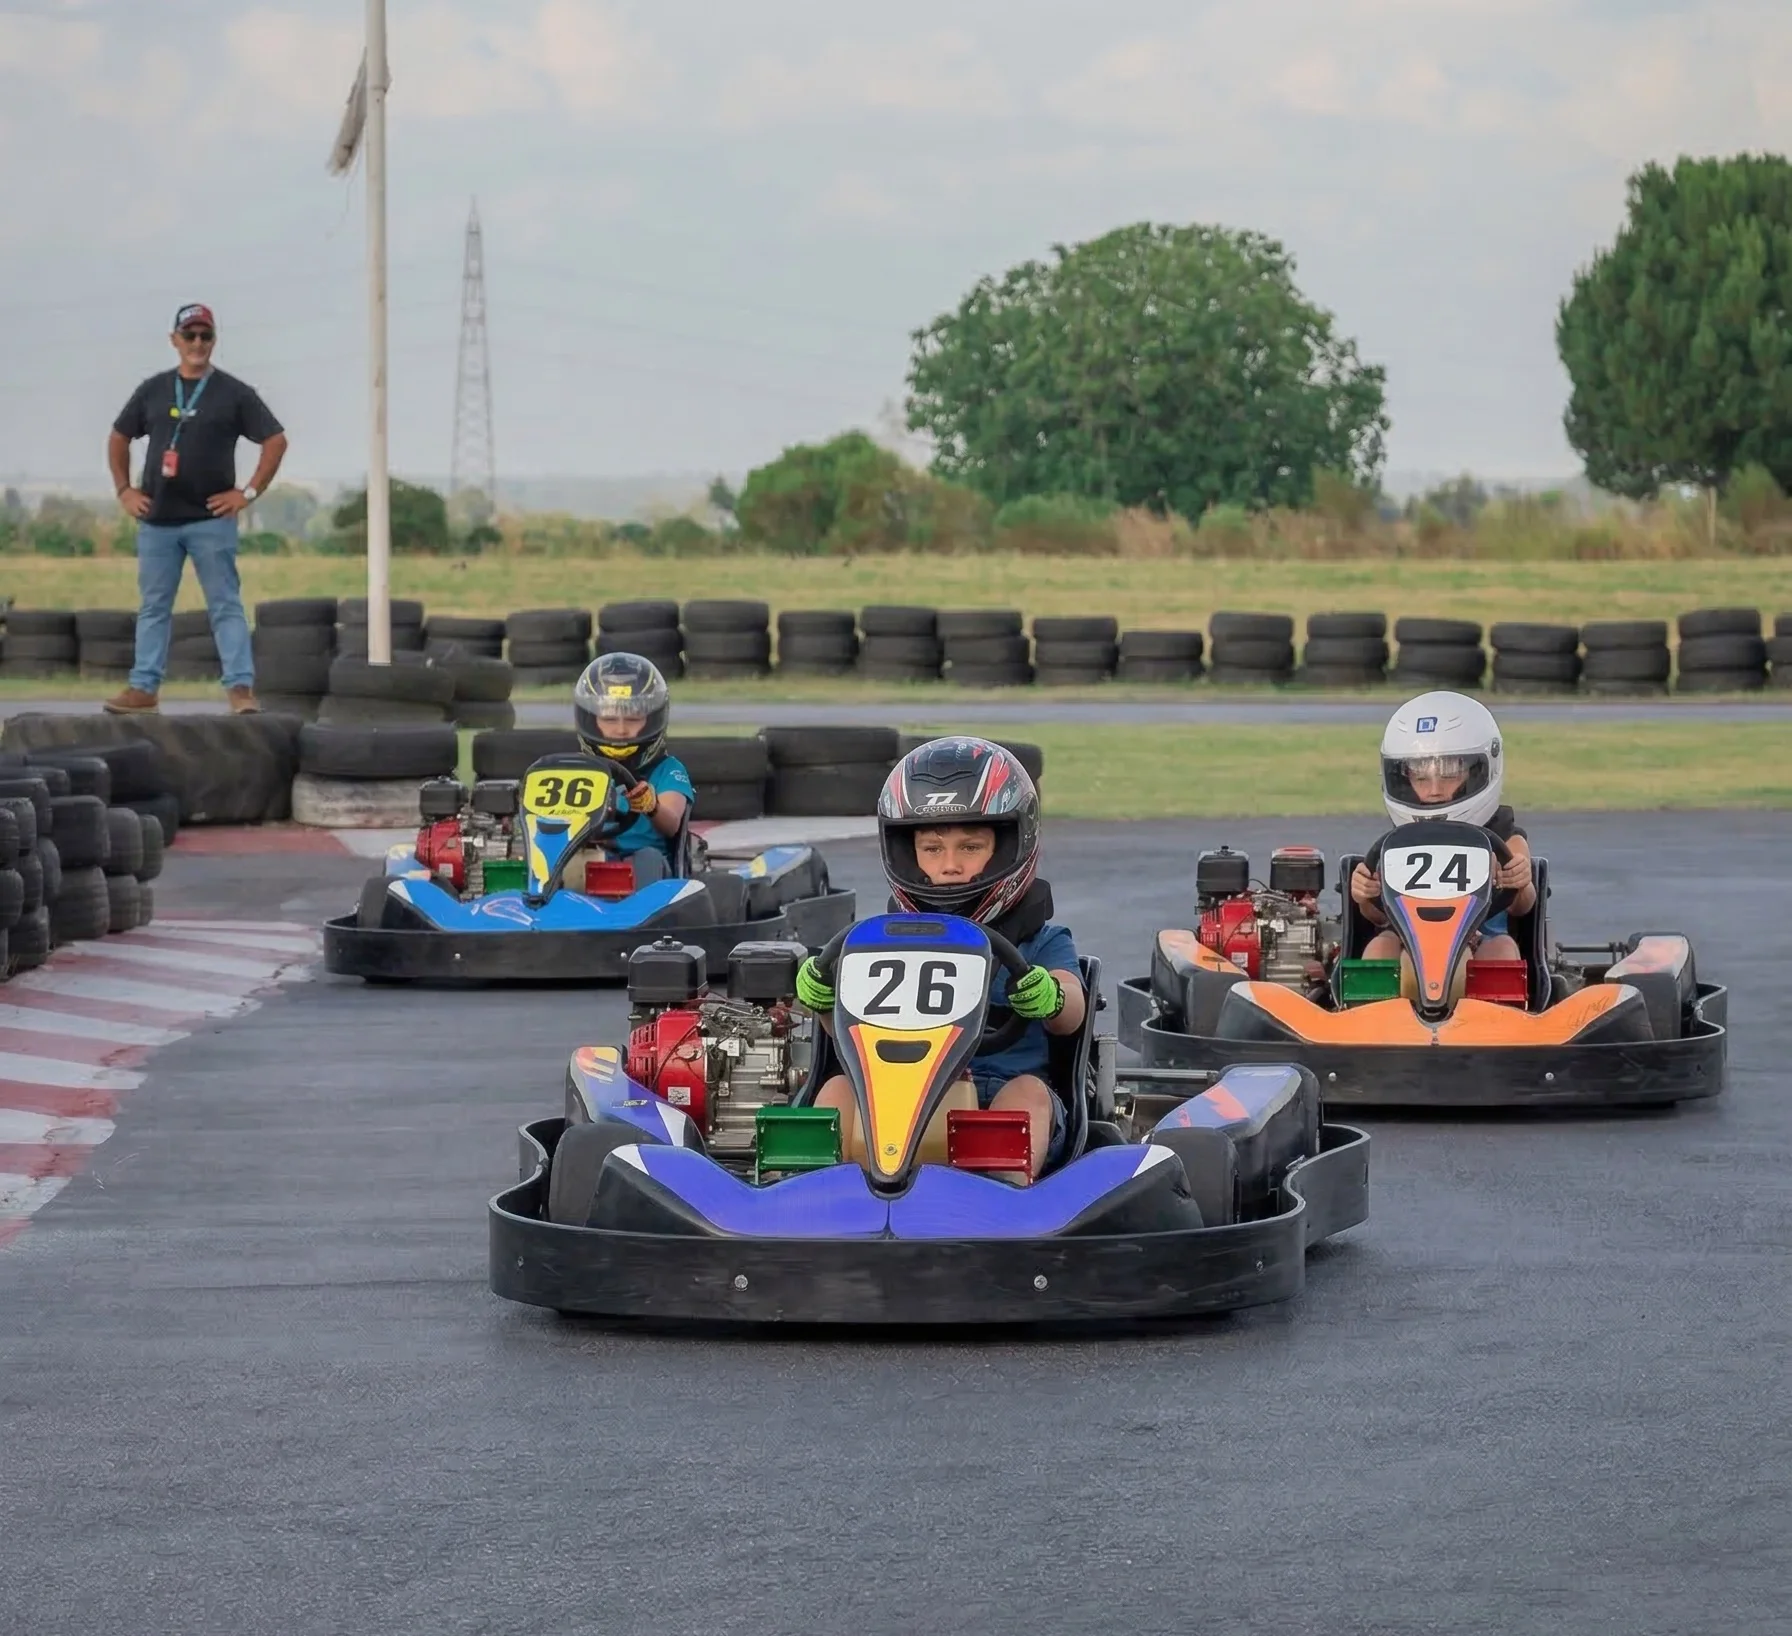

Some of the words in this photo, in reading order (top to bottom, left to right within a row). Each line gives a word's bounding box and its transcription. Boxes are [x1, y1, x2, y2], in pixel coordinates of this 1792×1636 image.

[534, 777, 594, 808] 36
[1405, 852, 1471, 892] 24
[863, 959, 957, 1016] 26
